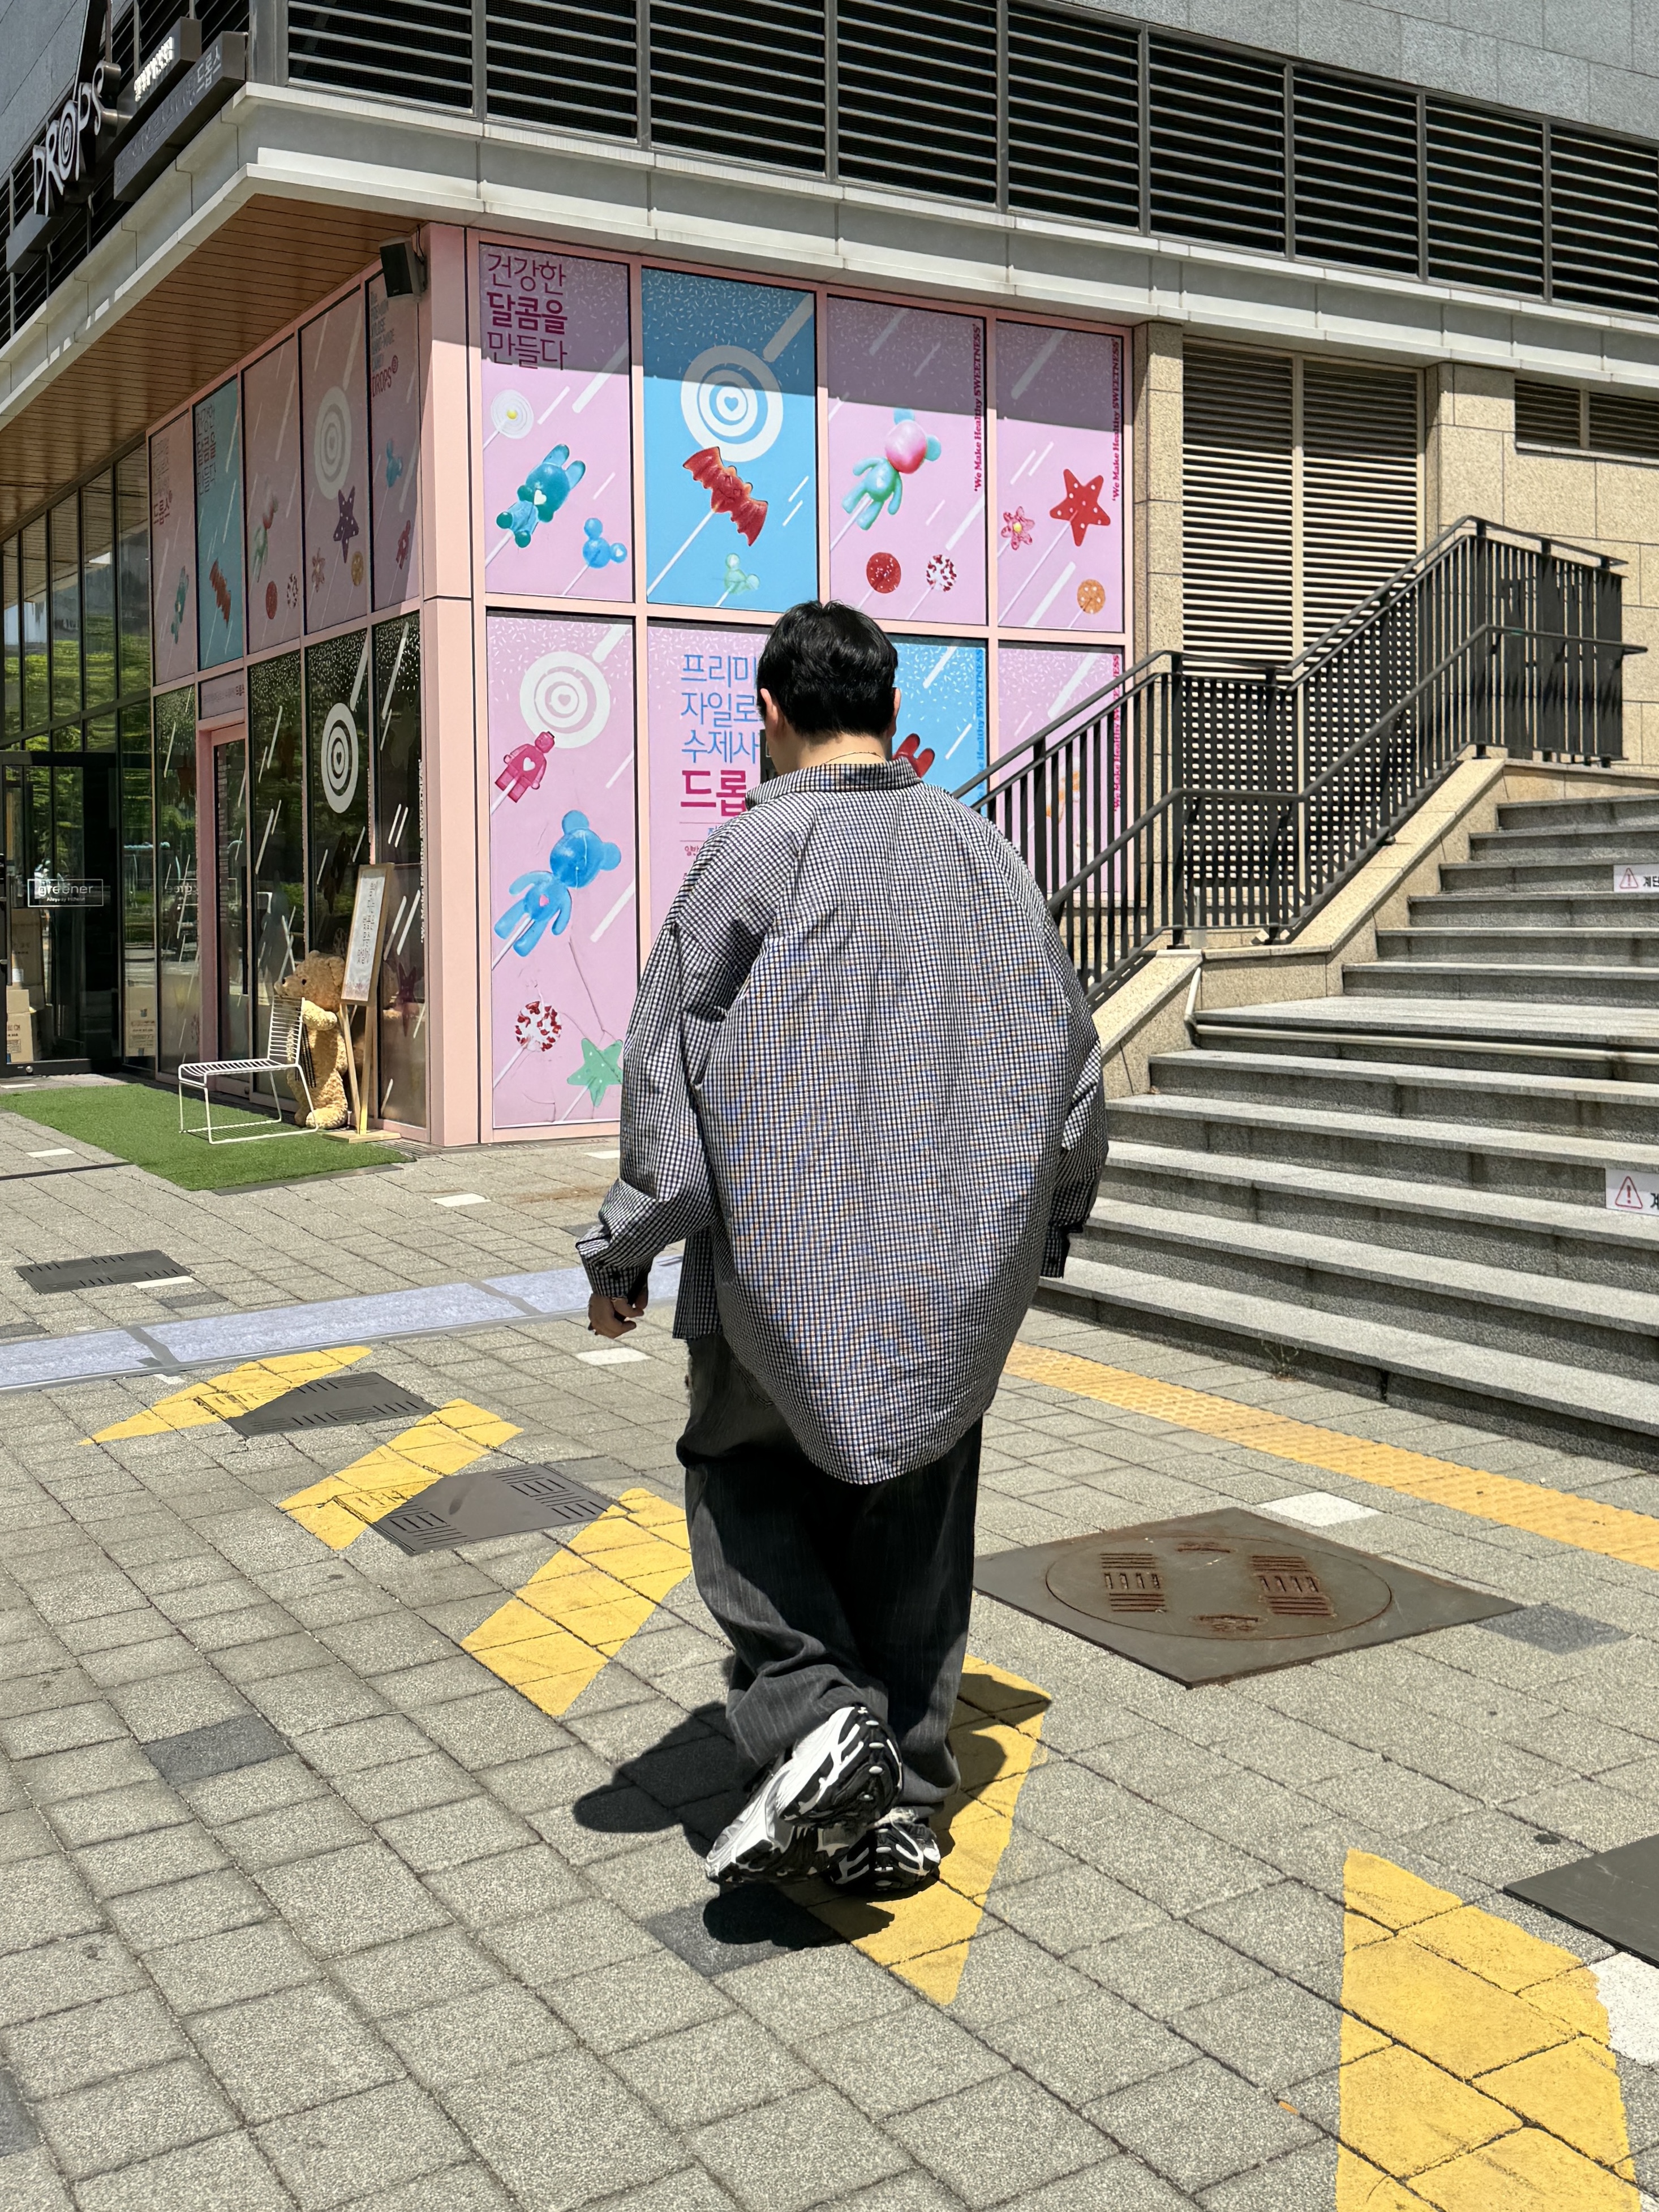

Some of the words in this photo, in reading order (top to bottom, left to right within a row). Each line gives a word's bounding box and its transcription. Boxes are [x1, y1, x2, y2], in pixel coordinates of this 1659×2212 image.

[196, 45, 222, 94] 드롭스
[32, 59, 104, 218] DROPS
[488, 254, 566, 295] 건강한
[487, 291, 568, 335] 달콤을
[487, 332, 568, 371] 만들다
[372, 367, 392, 397] DROPS
[974, 399, 982, 440] Healthy
[1112, 413, 1120, 450] Healthy
[154, 498, 170, 525] 드롭스
[681, 692, 763, 728] 자일로
[681, 770, 747, 817] 드롭
[38, 885, 93, 897] greener
